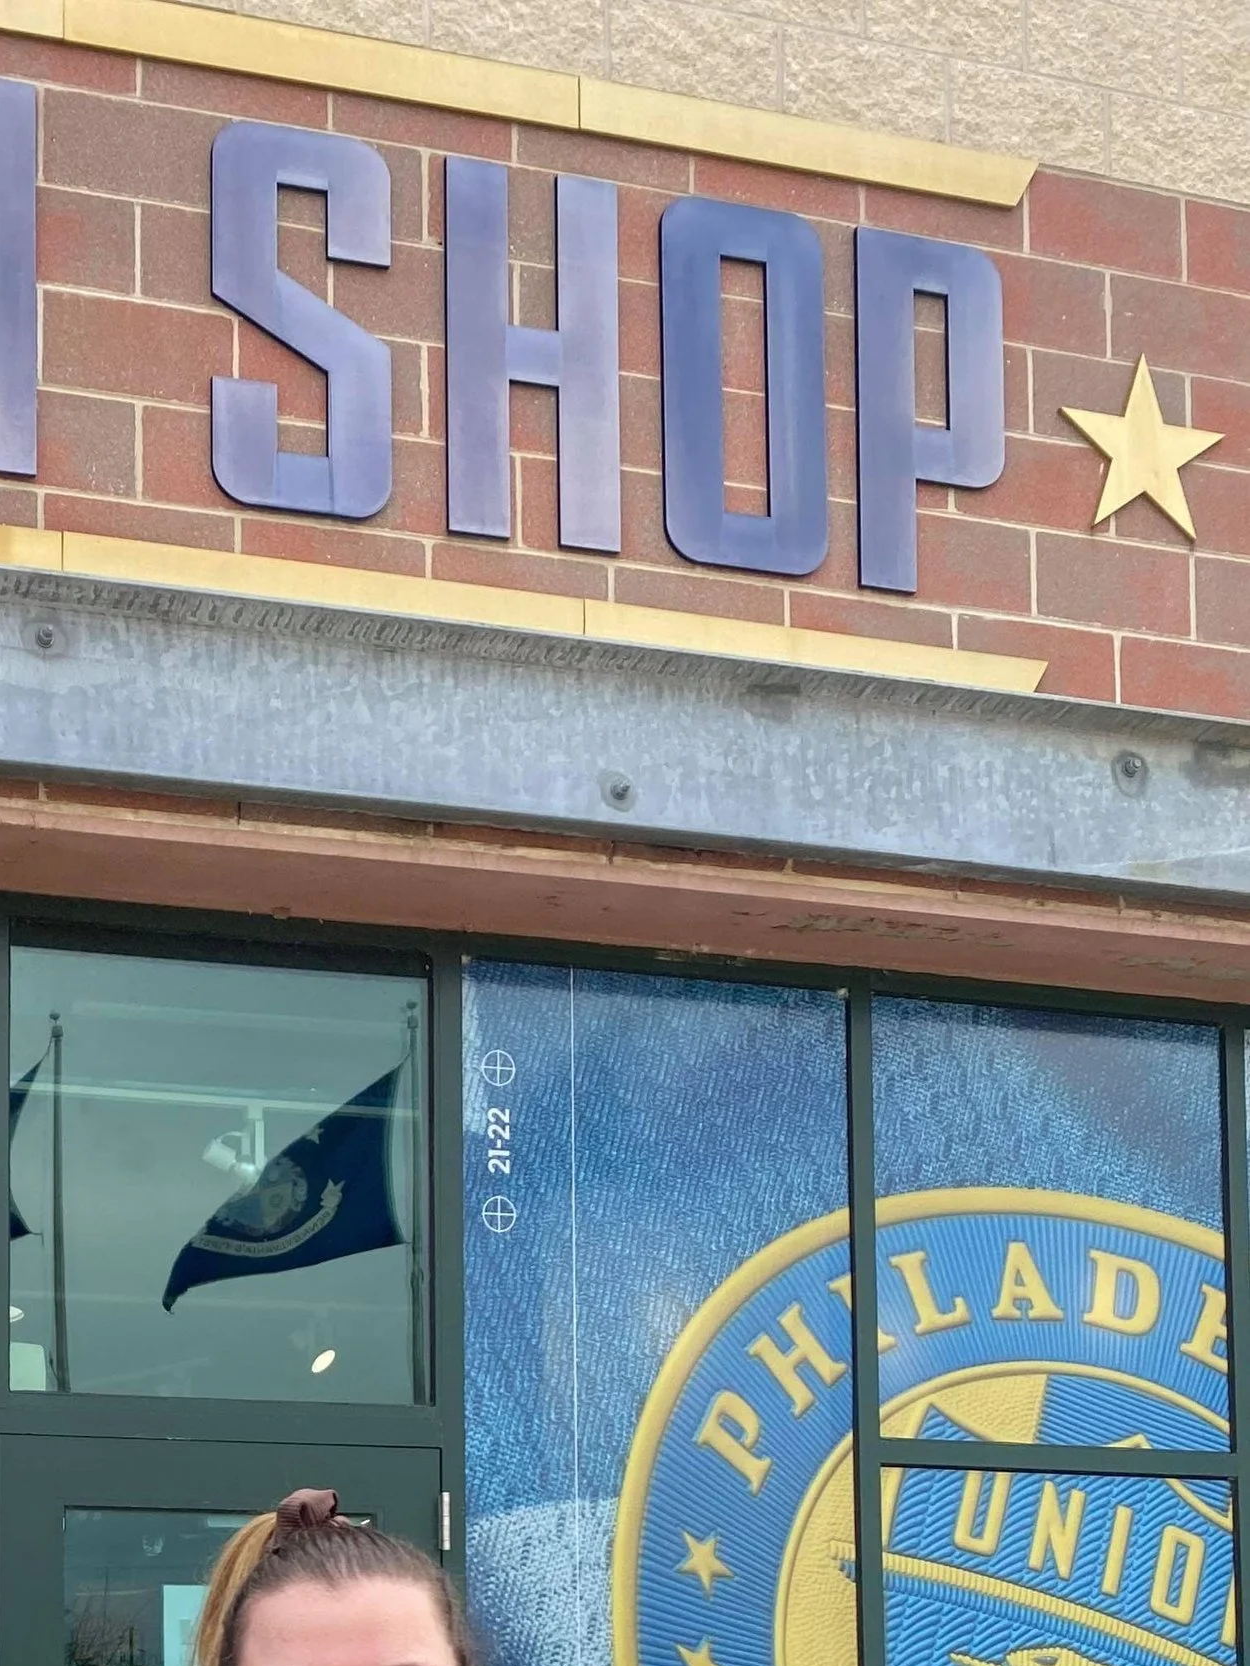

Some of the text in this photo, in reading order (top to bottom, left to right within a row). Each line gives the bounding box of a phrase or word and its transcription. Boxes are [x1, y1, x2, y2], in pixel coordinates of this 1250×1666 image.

[210, 119, 1006, 593] SHOP
[487, 1107, 510, 1175] 21-22
[953, 1468, 1236, 1648] UNIO
